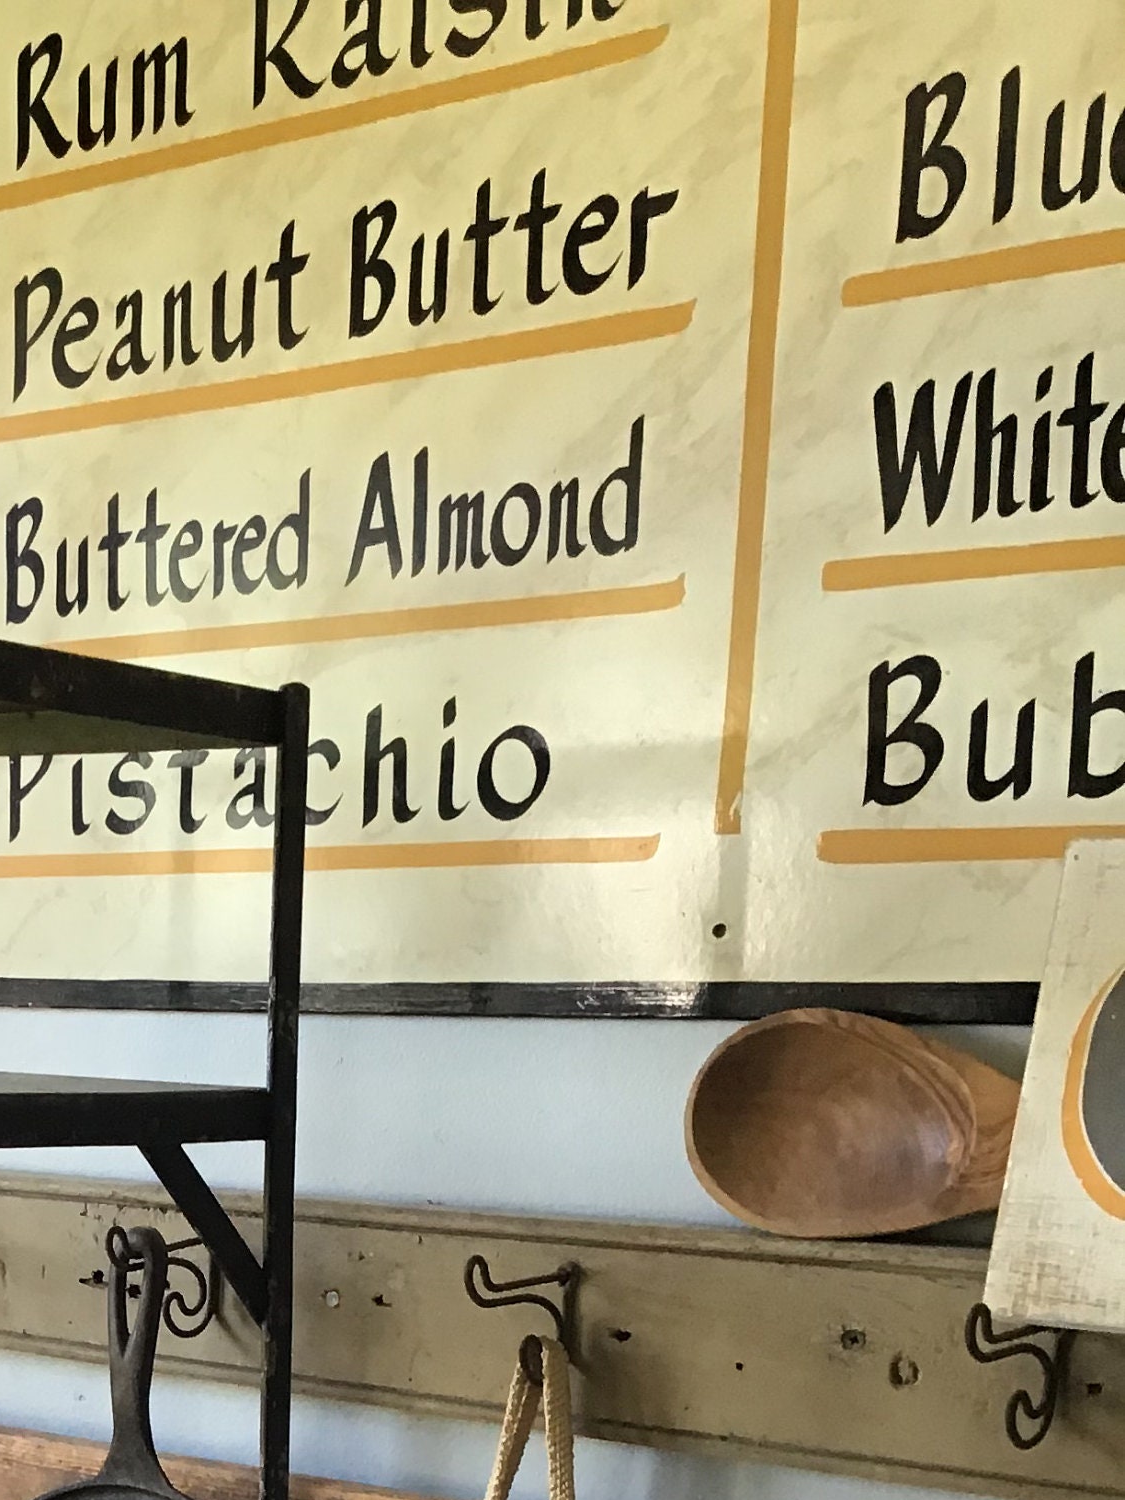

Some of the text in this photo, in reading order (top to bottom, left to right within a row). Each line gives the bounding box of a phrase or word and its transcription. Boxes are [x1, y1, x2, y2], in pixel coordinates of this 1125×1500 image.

[15, 0, 627, 171] Rum Rais
[895, 65, 1125, 244] Blu
[12, 167, 680, 403] Peanut Butter
[5, 414, 646, 625] Buttered Almond
[8, 696, 552, 844] Pistachio
